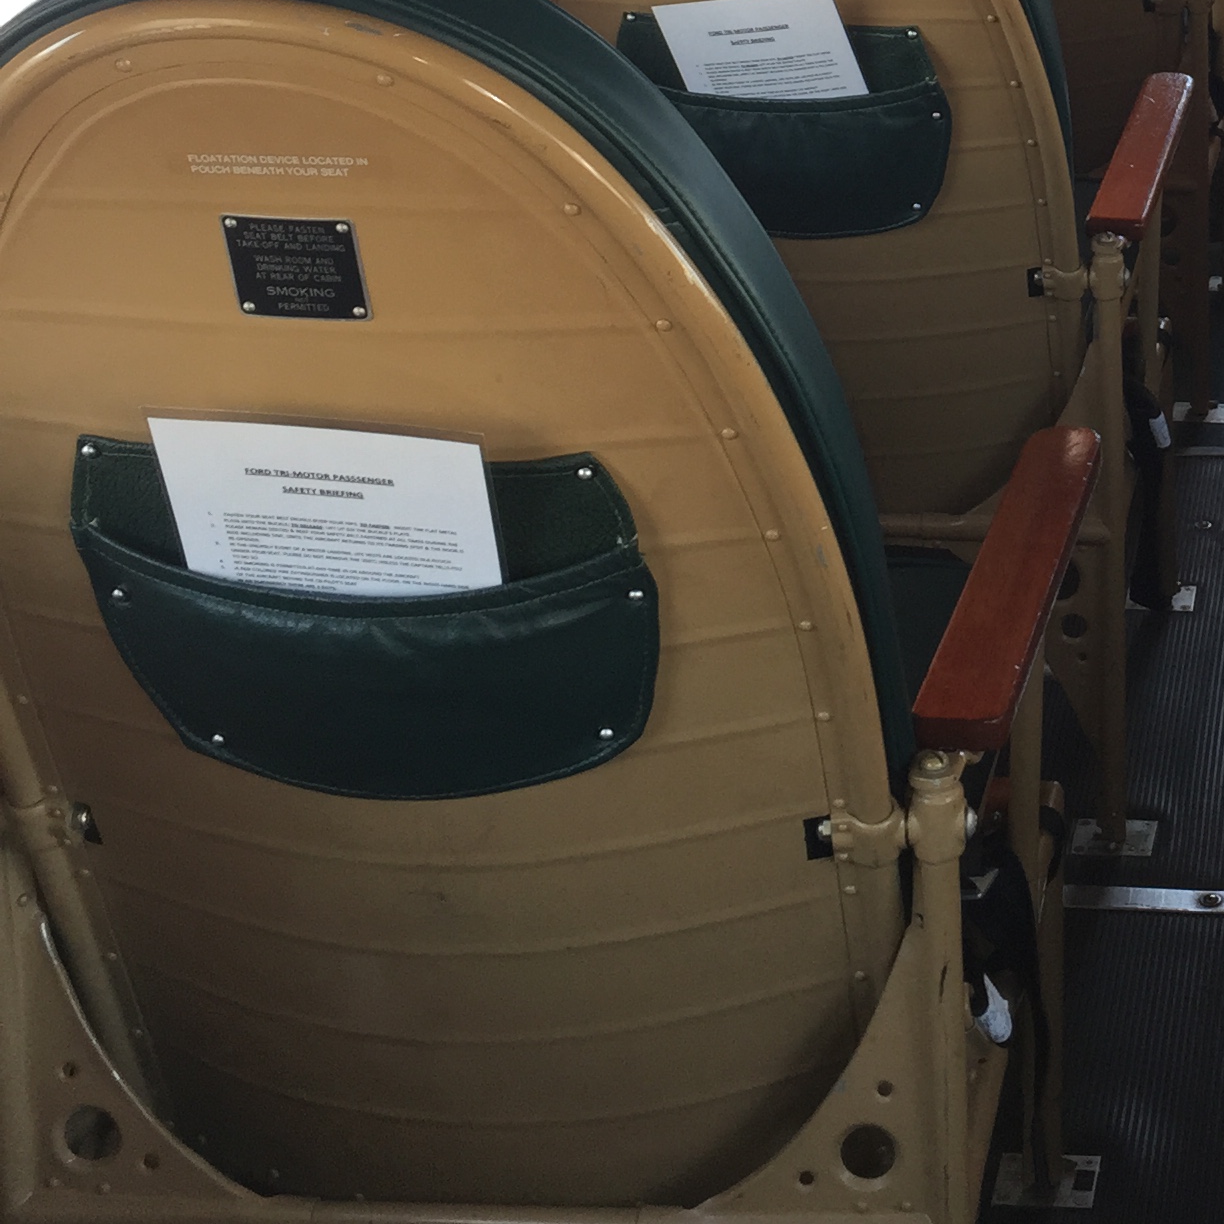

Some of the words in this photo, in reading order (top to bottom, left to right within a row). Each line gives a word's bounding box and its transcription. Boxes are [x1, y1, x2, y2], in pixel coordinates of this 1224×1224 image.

[187, 154, 257, 164] FLOATATION
[259, 155, 299, 165] DEVICE
[302, 156, 354, 166] LOCATED
[356, 158, 368, 166] IN
[191, 165, 230, 174] POUCH
[232, 166, 285, 175] BENEATH
[285, 167, 318, 176] YOUR
[320, 167, 349, 177] SEAT
[249, 222, 285, 232] PLEASE
[243, 231, 267, 240] SEAT
[270, 233, 293, 242] BELT
[297, 234, 334, 243] BEFORE
[284, 242, 303, 251] AND
[305, 243, 346, 252] LANDING
[254, 255, 282, 263] WASH
[285, 256, 311, 264] ROOM
[315, 257, 334, 265] AND
[302, 266, 337, 274] WATER
[256, 272, 267, 280] AT
[270, 272, 295, 281] REAR
[297, 273, 310, 282] OF
[266, 286, 336, 298] SMOKING
[277, 302, 330, 312] PERMITTED
[244, 467, 271, 476] FORD
[273, 469, 330, 480] TRI-MOTOR
[282, 486, 317, 495] SAFETY
[319, 489, 364, 499] BRIEFING
